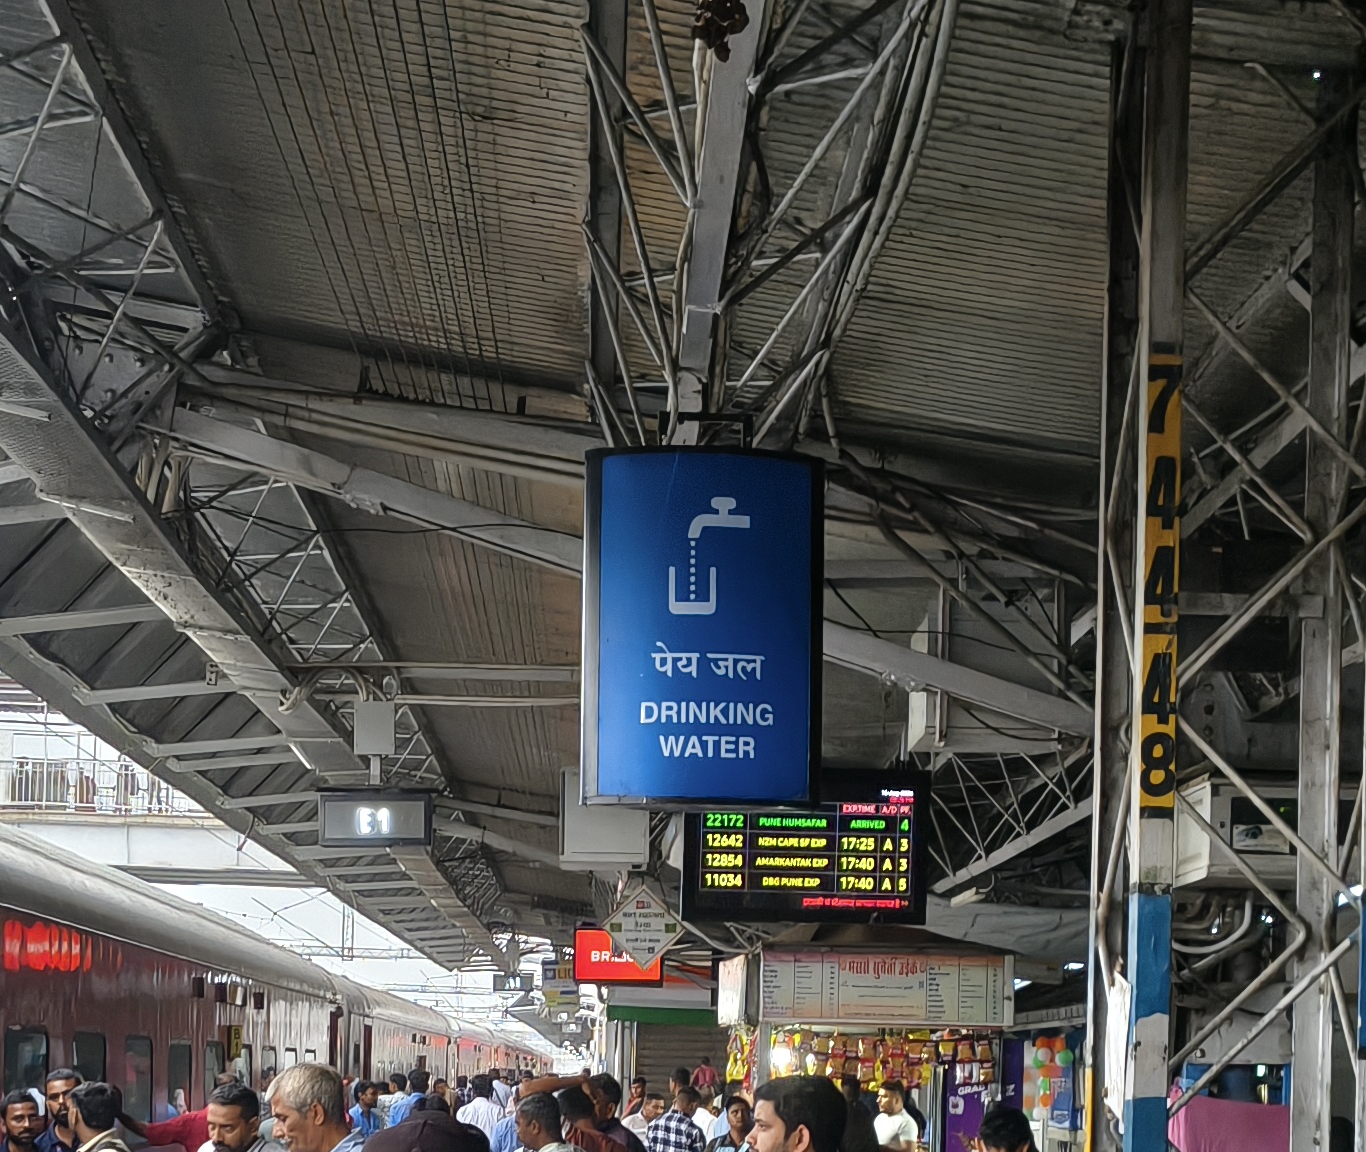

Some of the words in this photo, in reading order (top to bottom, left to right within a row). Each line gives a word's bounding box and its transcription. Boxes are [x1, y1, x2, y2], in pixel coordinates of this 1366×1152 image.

[651, 641, 700, 678] पेय
[706, 652, 765, 680] जल
[640, 701, 773, 726] DRINKING
[659, 735, 755, 758] WATER
[706, 814, 744, 827] 22172
[759, 817, 782, 827] PUNE
[850, 819, 886, 829] ARRIVED
[900, 819, 909, 831] 4
[706, 834, 744, 847] 12642
[811, 838, 827, 848] EXP
[841, 837, 875, 851] 17:25
[883, 838, 893, 851] A
[899, 838, 909, 852] 3
[705, 854, 743, 867] 12854
[755, 856, 812, 867] AMARKANTAK
[812, 858, 829, 868] EXP
[841, 857, 875, 871] 17:40
[882, 858, 893, 871] A
[899, 858, 908, 872] 3
[705, 873, 743, 887] 11034
[781, 877, 803, 887] PUNE
[804, 878, 821, 888] EXP
[840, 877, 874, 890] 17:40
[882, 878, 892, 891] A
